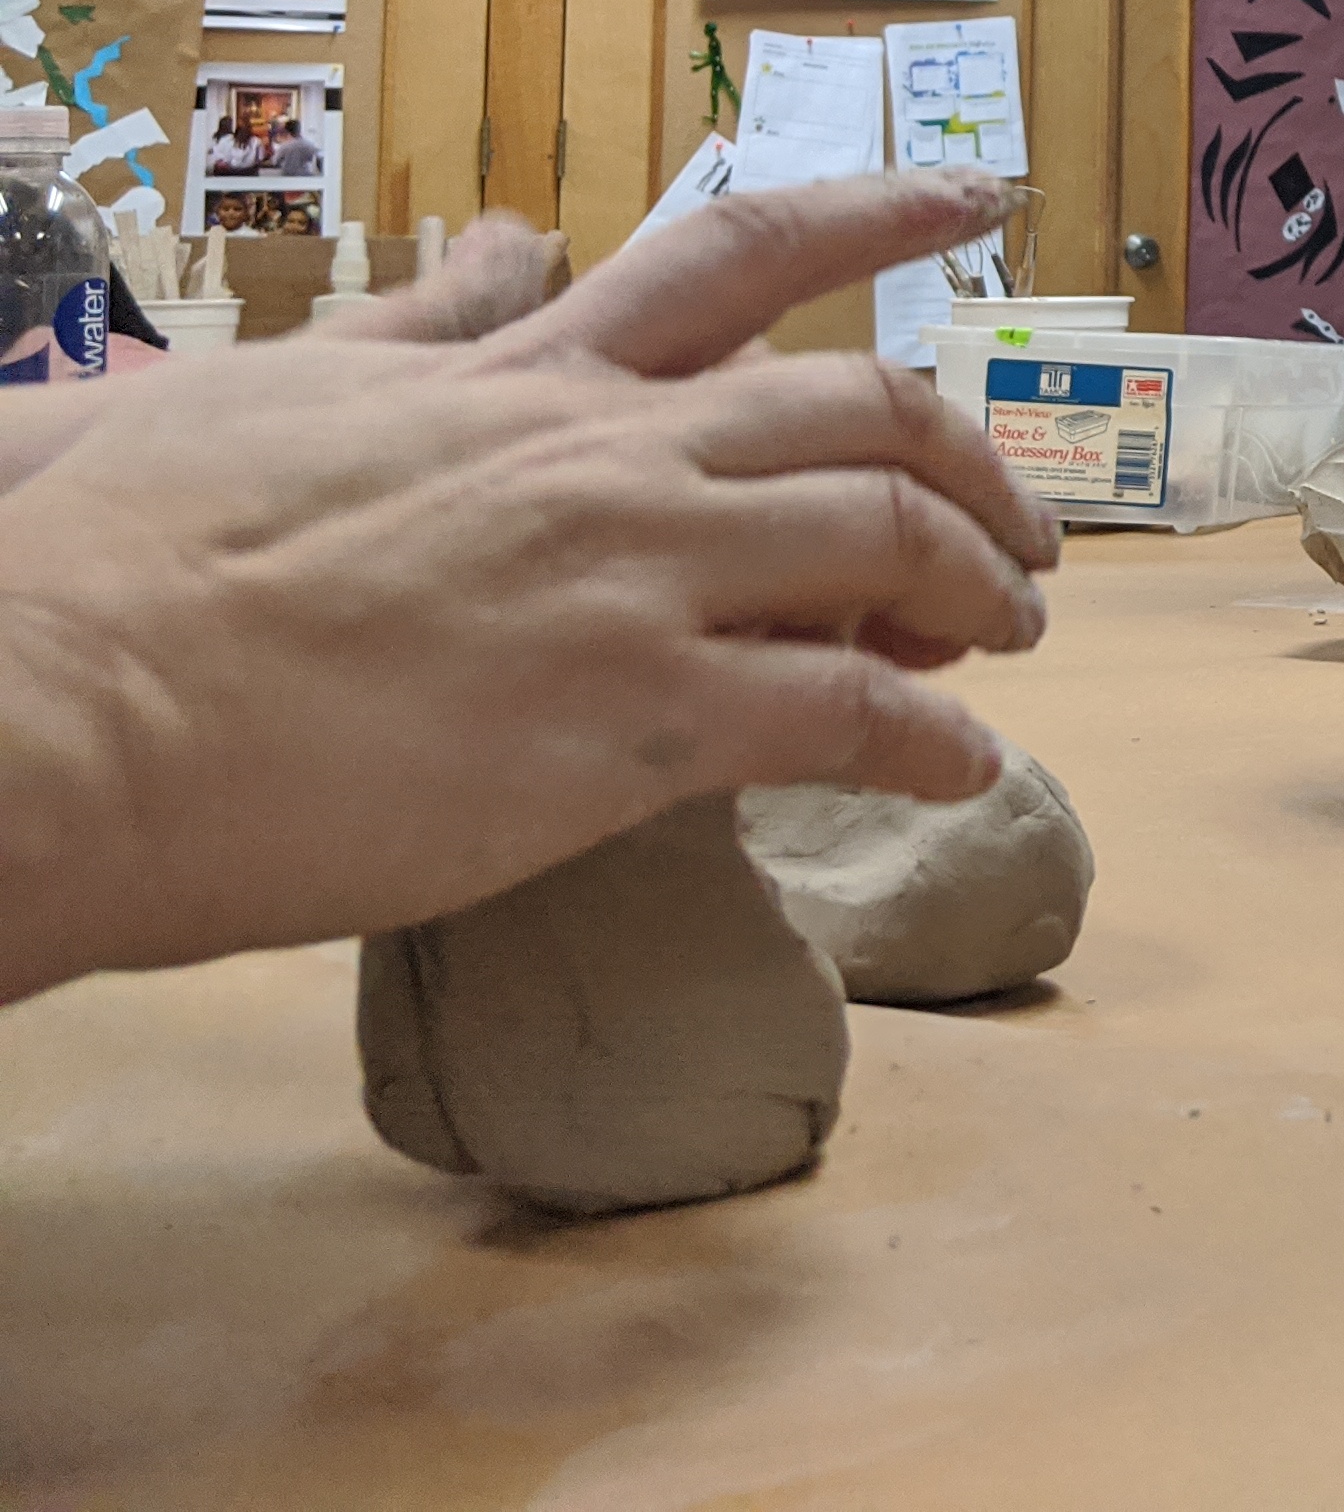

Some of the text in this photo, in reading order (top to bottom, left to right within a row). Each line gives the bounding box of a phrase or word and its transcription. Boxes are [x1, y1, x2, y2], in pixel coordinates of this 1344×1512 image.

[993, 424, 1047, 441] Shoe &
[996, 442, 1069, 464] Accessory
[1071, 446, 1103, 462] Box
